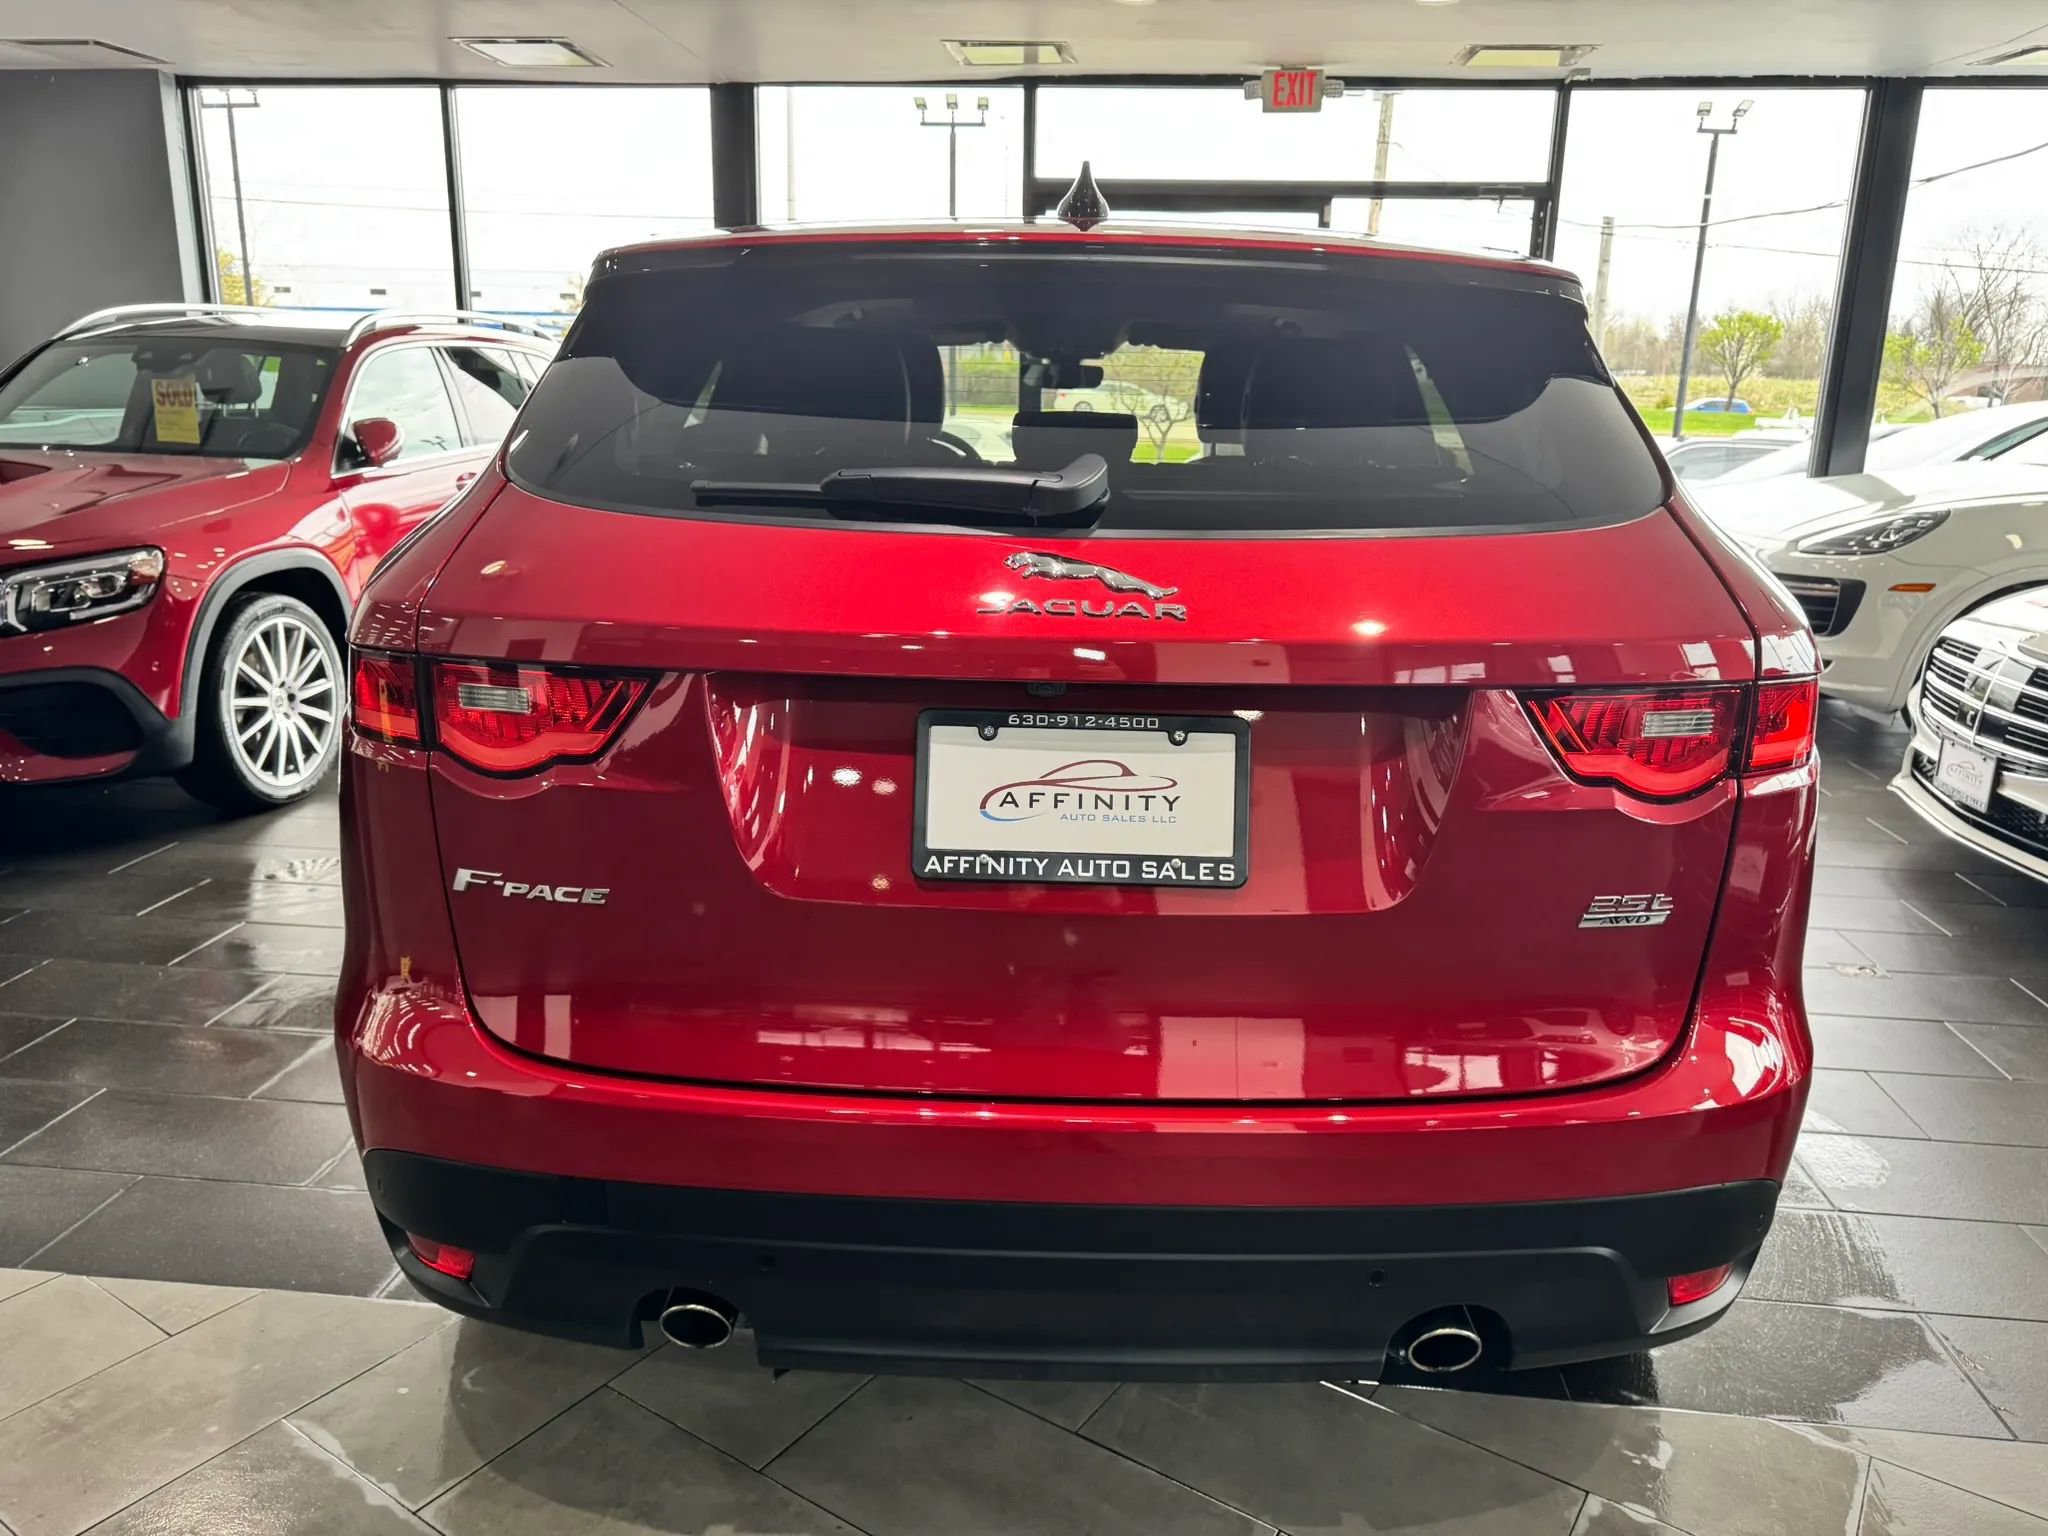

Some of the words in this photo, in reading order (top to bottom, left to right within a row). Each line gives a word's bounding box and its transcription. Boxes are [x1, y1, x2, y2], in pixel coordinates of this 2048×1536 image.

[1272, 71, 1317, 107] EXIT
[155, 380, 193, 408] SOLD
[1007, 714, 1159, 729] 630-912-4500
[998, 791, 1182, 812] AFFINITY
[1060, 813, 1096, 822] AUTO
[1102, 814, 1147, 823] SALES
[1152, 815, 1177, 824] LLC
[924, 855, 1049, 876] AFFINITY
[1057, 859, 1131, 879] AUTO
[1142, 861, 1235, 882] SALES
[452, 867, 610, 905] F-PACE
[1600, 915, 1650, 925] AWD
